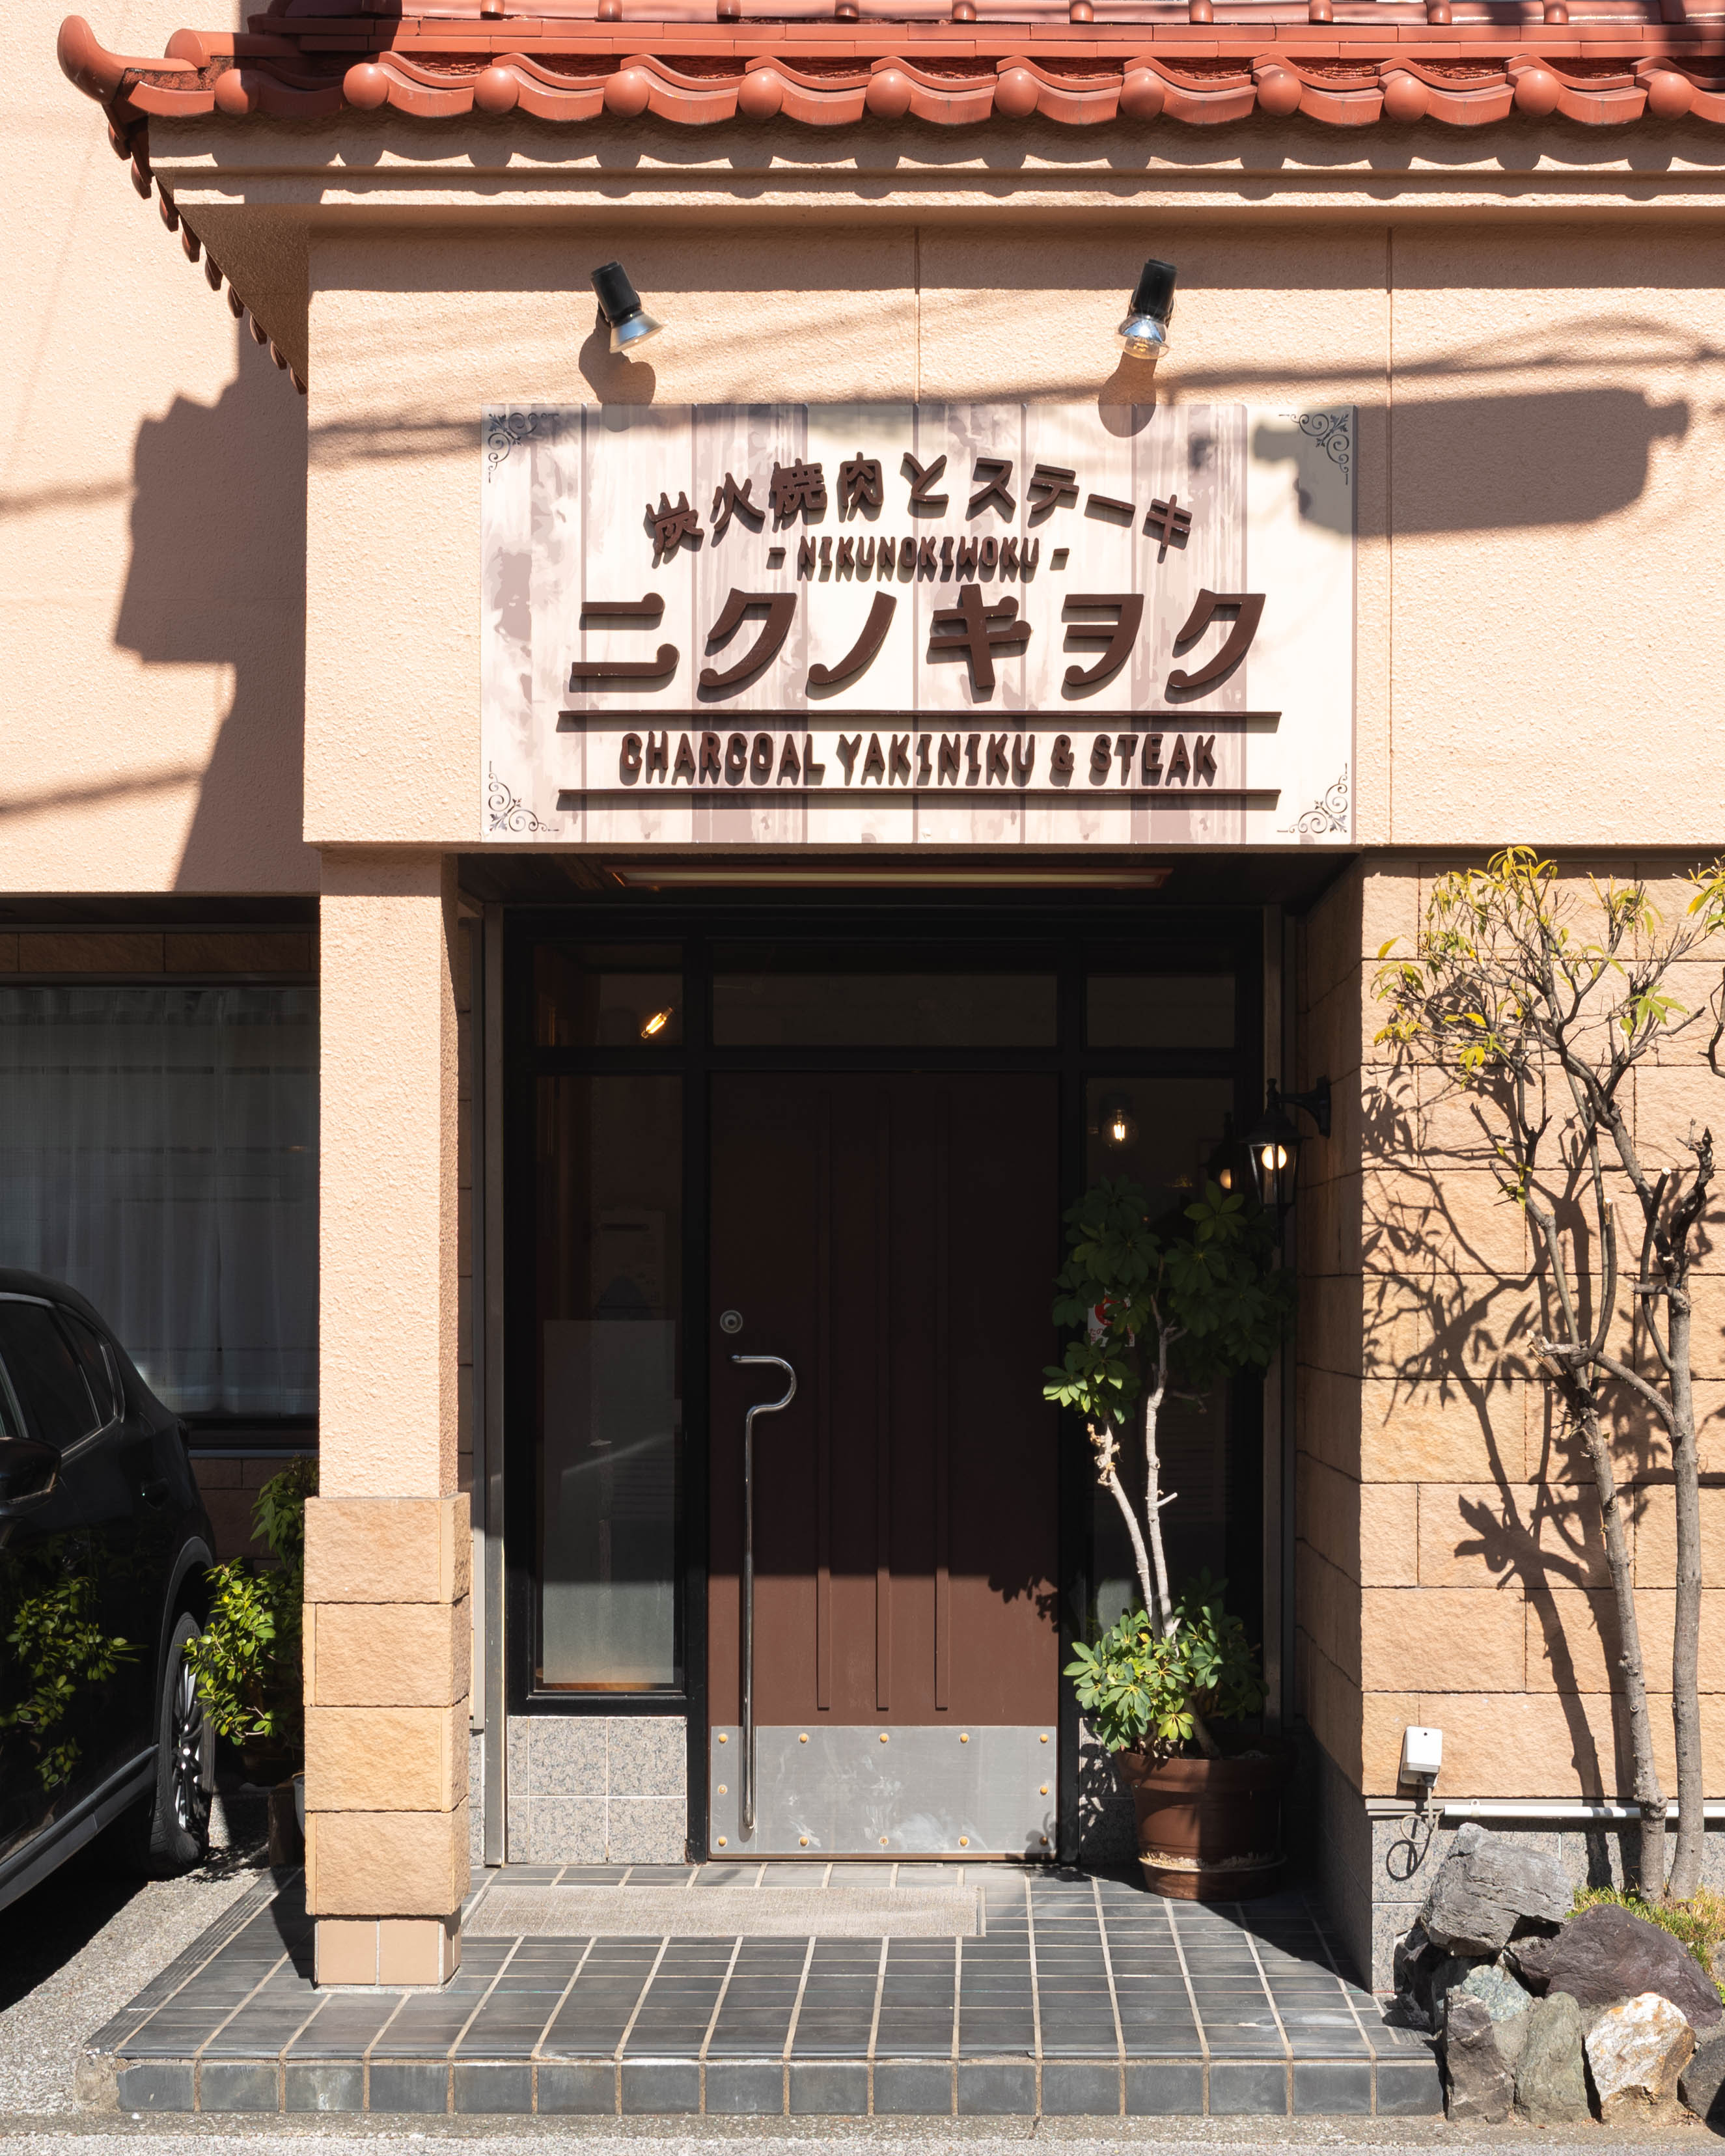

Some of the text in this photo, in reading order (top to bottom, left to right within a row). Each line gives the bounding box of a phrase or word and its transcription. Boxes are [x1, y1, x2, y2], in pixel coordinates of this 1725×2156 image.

[644, 452, 1193, 555] 炭火焼肉とステーキ
[572, 584, 1266, 689] ニクノキヲク
[621, 730, 1217, 771] CHARCOAL YAKINIKU & STEAK
